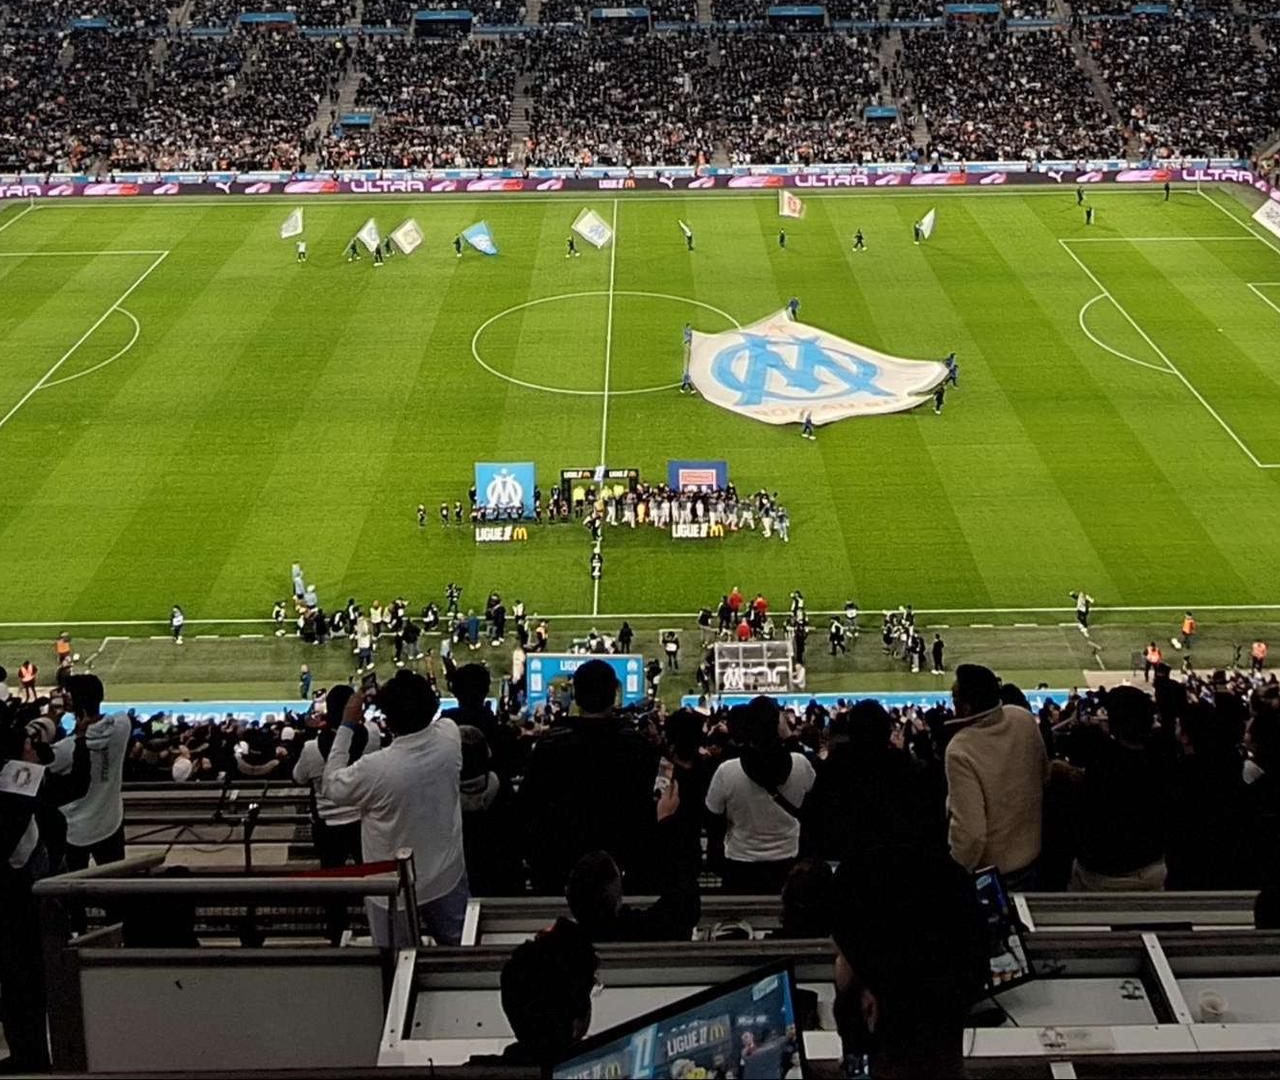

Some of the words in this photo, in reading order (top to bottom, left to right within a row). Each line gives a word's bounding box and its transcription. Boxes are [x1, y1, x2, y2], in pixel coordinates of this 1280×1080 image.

[794, 173, 869, 187] ULTRA
[1182, 168, 1254, 184] ULTRA
[351, 179, 425, 193] ULTRA
[475, 527, 504, 542] LIGUE
[672, 524, 700, 538] LIGUE
[666, 1029, 700, 1057] LIGUE
